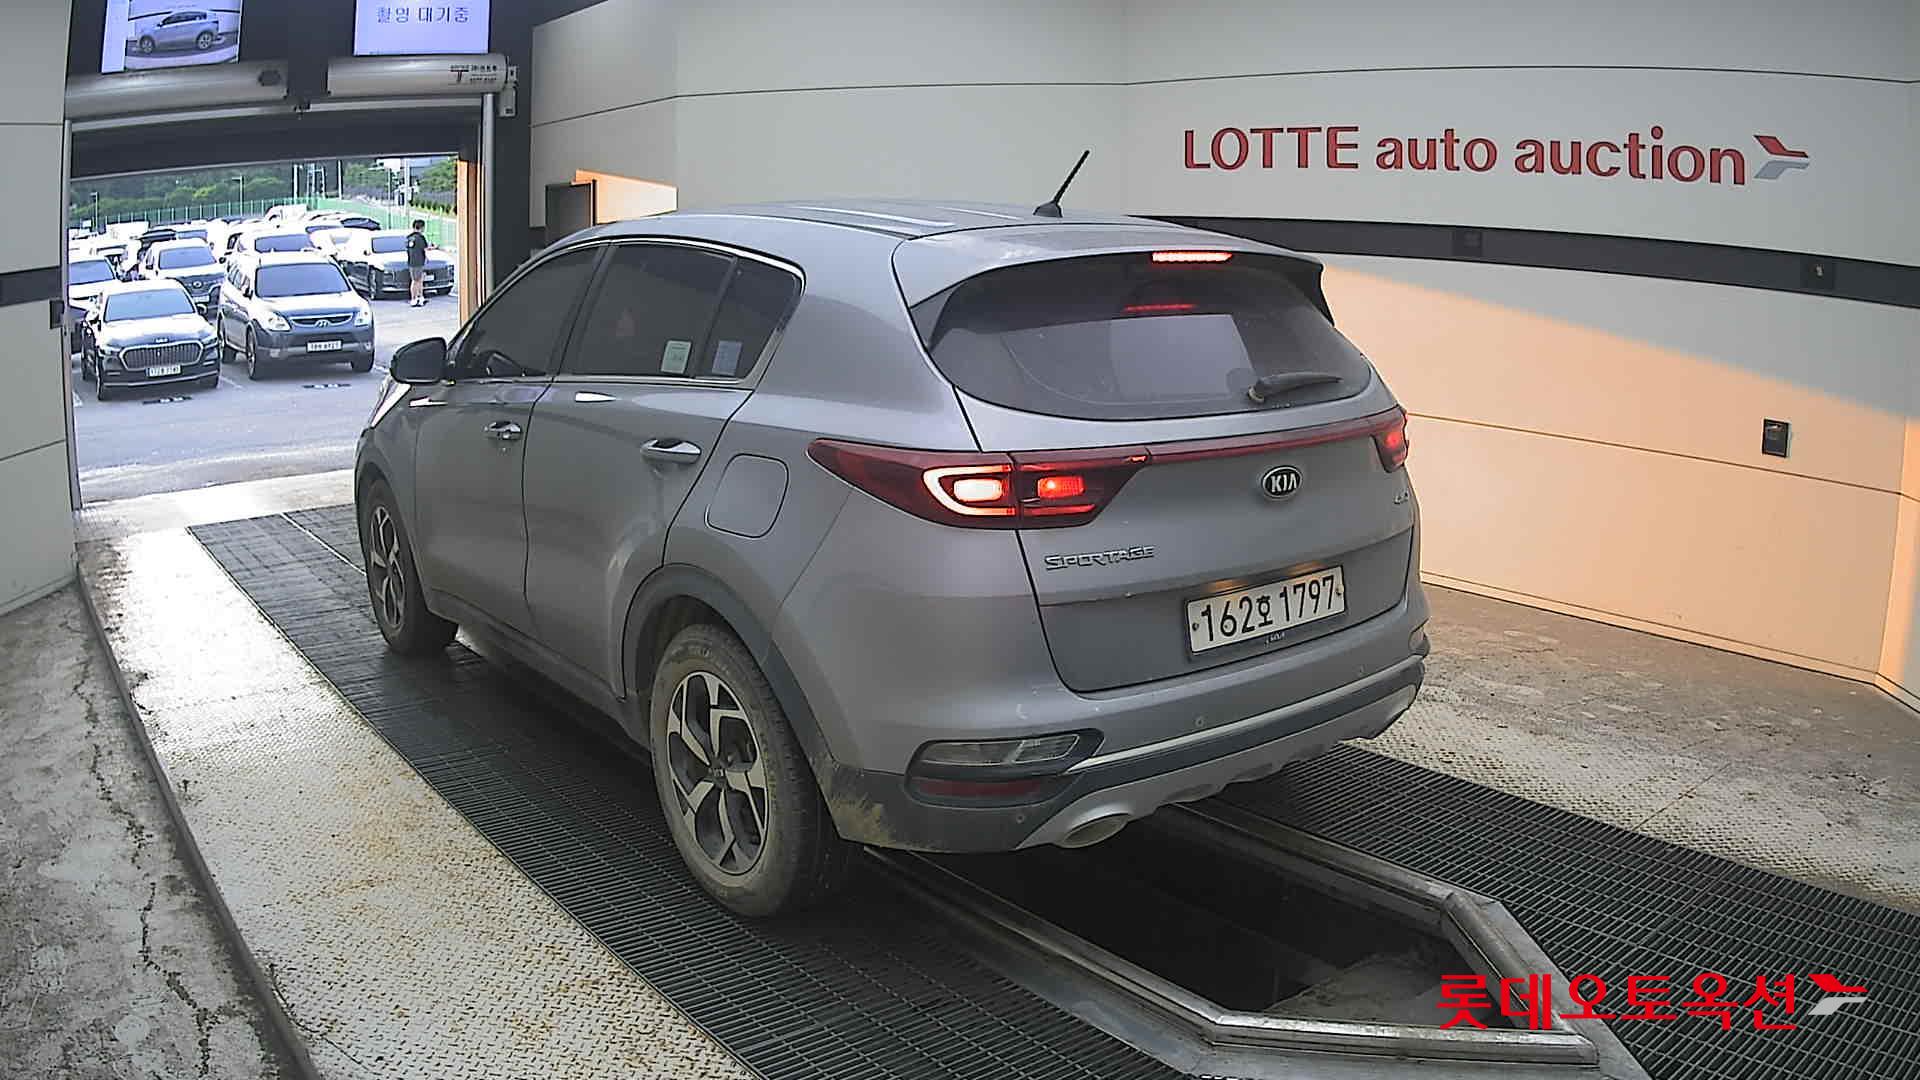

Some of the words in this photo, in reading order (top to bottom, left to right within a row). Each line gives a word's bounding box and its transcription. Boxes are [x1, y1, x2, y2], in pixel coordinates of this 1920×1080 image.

[418, 6, 470, 23] 대기중
[1184, 126, 1359, 170] LOTTE
[1375, 128, 1498, 172] auto
[1514, 125, 1746, 186] auction
[1270, 473, 1298, 493] KIA
[1044, 545, 1155, 571] SPORTAGE
[1200, 595, 1274, 642] 162호
[1279, 575, 1335, 622] 1797
